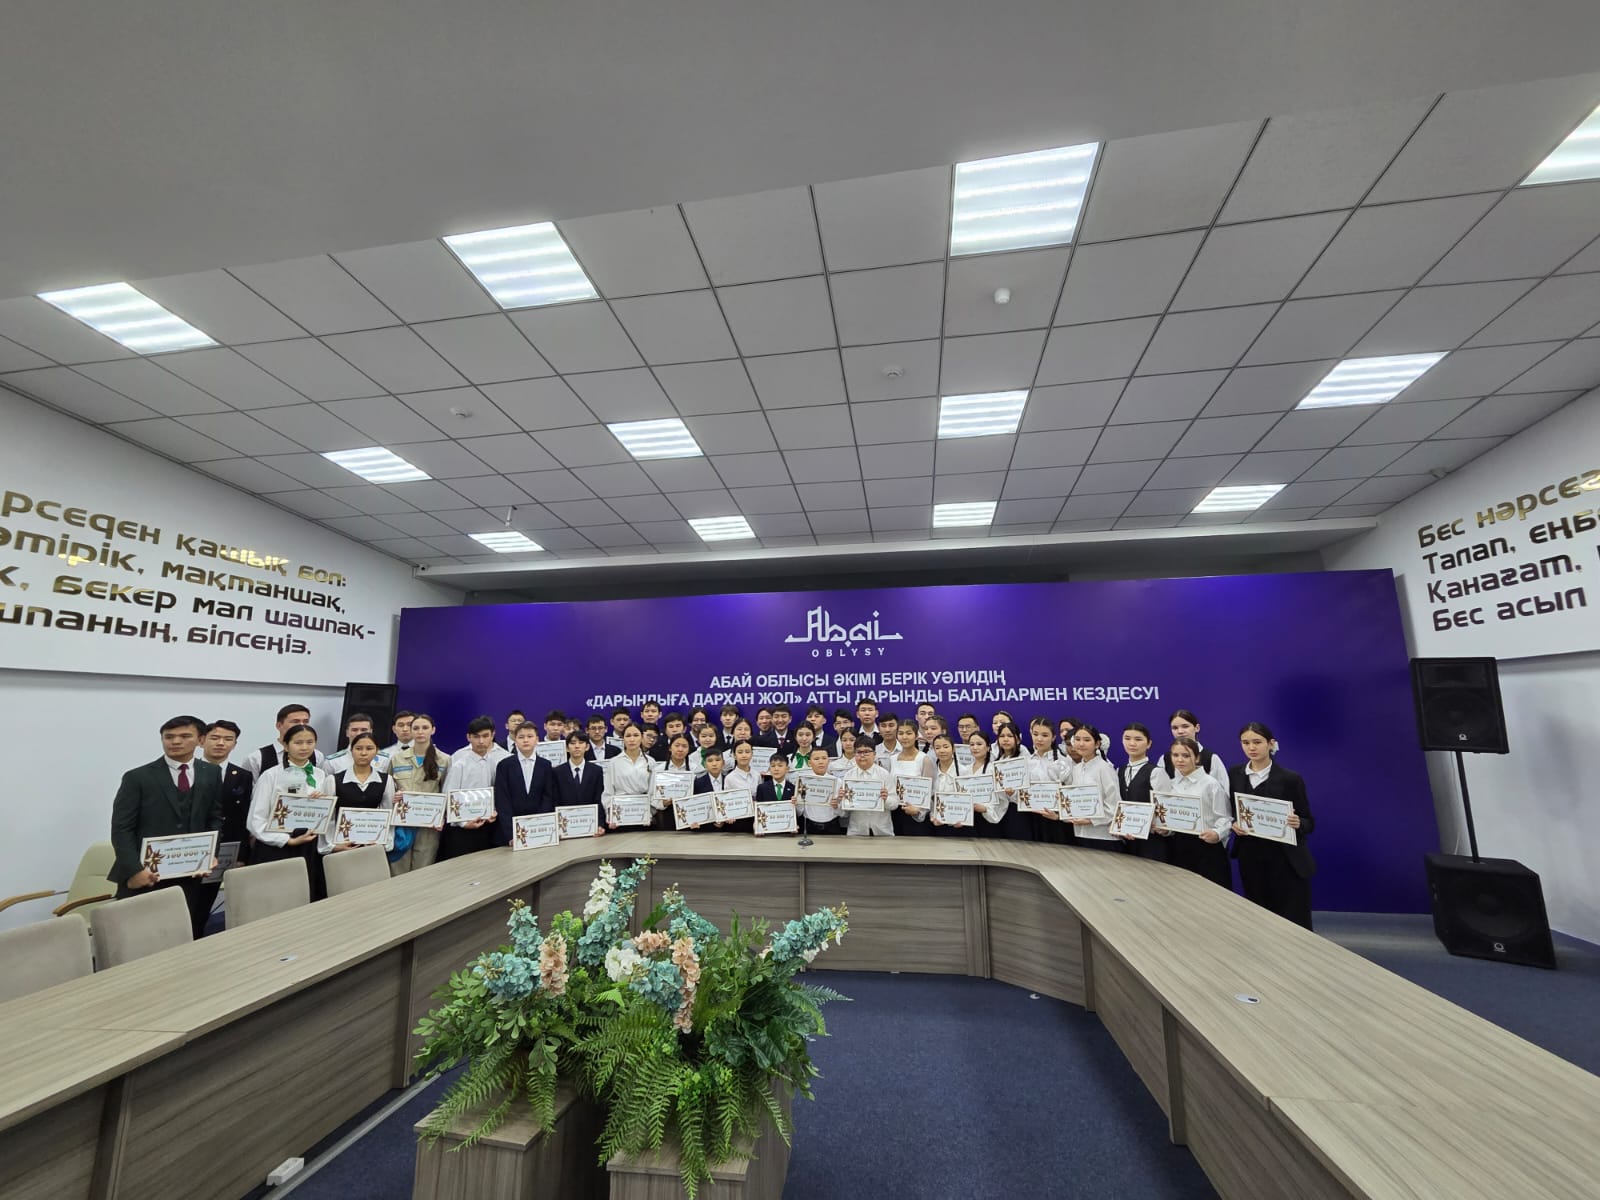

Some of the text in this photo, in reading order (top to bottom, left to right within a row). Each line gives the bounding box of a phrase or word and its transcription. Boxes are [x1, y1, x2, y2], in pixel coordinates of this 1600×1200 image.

[1418, 518, 1465, 548] Бес
[1529, 508, 1600, 544] еңб
[52, 575, 177, 614] бекер
[161, 561, 345, 614] мақтаншақ,
[1433, 587, 1587, 631] Бес асыл
[811, 648, 885, 658] OBLYSY
[709, 670, 1006, 688] АБАЙ ОБЛЫСЫ ӘКІМІ БЕРІК УӘЛИДІҢ
[692, 692, 754, 708] ДАРХАН
[758, 691, 802, 705] ЖОЛ»
[806, 690, 850, 704] АТТЫ
[854, 689, 942, 705] ДАРЫНДЫ
[948, 687, 1067, 702] БАЛАЛАРМЕН
[1073, 686, 1159, 702] КЕЗДЕСУІ
